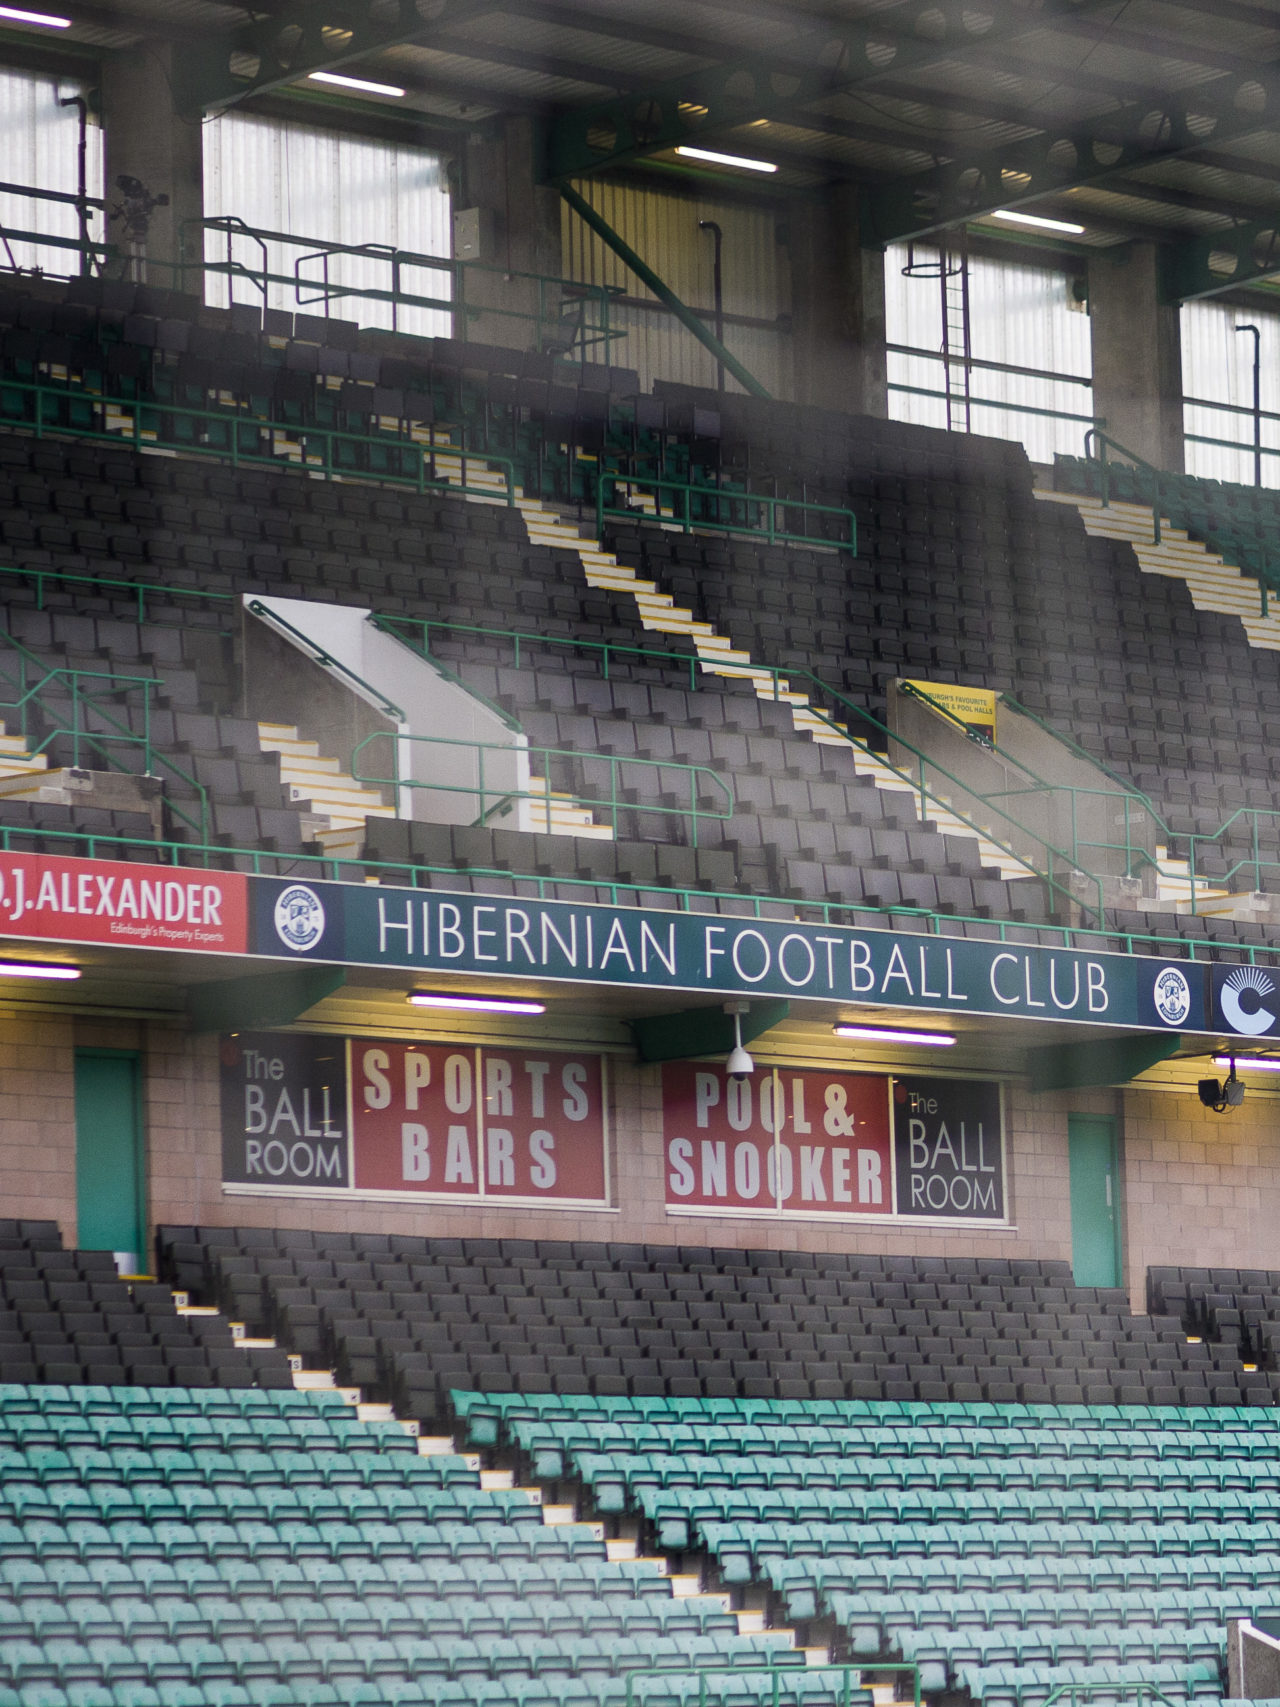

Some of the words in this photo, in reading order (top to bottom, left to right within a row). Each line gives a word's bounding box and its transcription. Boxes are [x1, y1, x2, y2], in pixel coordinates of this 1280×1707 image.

[974, 706, 993, 714] HALLS
[110, 922, 158, 938] Edinburgh's
[159, 926, 193, 942] Property
[194, 929, 225, 943] Experts
[378, 897, 677, 976] HIBERNIAN
[705, 925, 968, 1001] FOOTBALL
[990, 952, 1109, 1013] CLUB
[242, 1049, 284, 1080] The
[362, 1048, 589, 1122] SPORTS
[244, 1085, 343, 1138] BALL
[695, 1072, 812, 1135] POOL
[823, 1083, 856, 1137] &
[908, 1092, 938, 1115] The
[245, 1139, 342, 1179] ROOM
[401, 1122, 557, 1189] BARS
[668, 1137, 883, 1204] SNOOKER
[909, 1118, 996, 1172] BALL
[911, 1174, 997, 1211] ROOM
